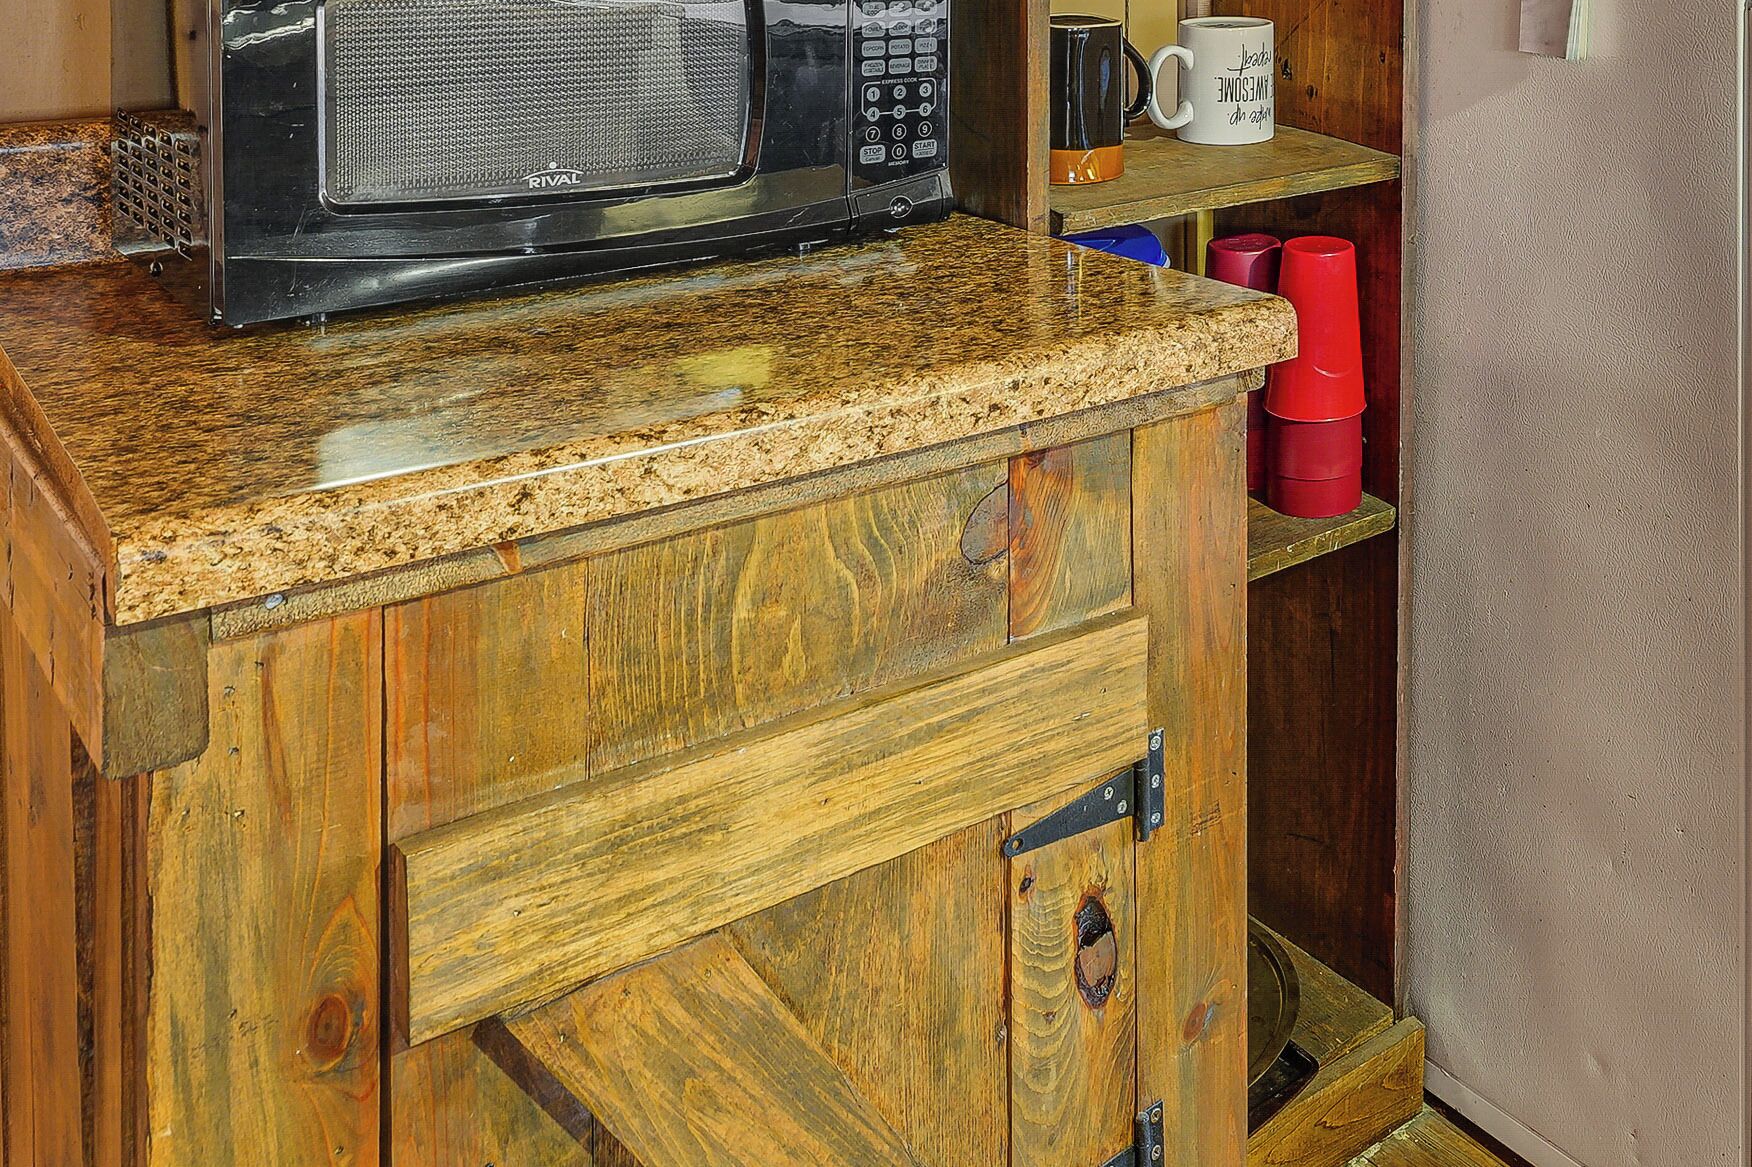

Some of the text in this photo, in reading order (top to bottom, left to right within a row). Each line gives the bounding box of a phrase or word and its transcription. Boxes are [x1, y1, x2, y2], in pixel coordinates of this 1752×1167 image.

[1226, 41, 1272, 77] repeat.
[897, 88, 903, 96] 2
[1214, 74, 1269, 102] AWESOME.
[871, 91, 876, 99] 1
[897, 108, 903, 116] 5
[923, 105, 929, 113] 6
[869, 111, 876, 119] 4
[1226, 104, 1246, 126] up.
[896, 127, 903, 136] 8
[922, 125, 928, 134] 9
[869, 130, 876, 139] 7
[914, 141, 935, 149] START
[864, 147, 882, 155] STOP
[896, 147, 902, 156] 0
[528, 173, 581, 189] RIVAL
